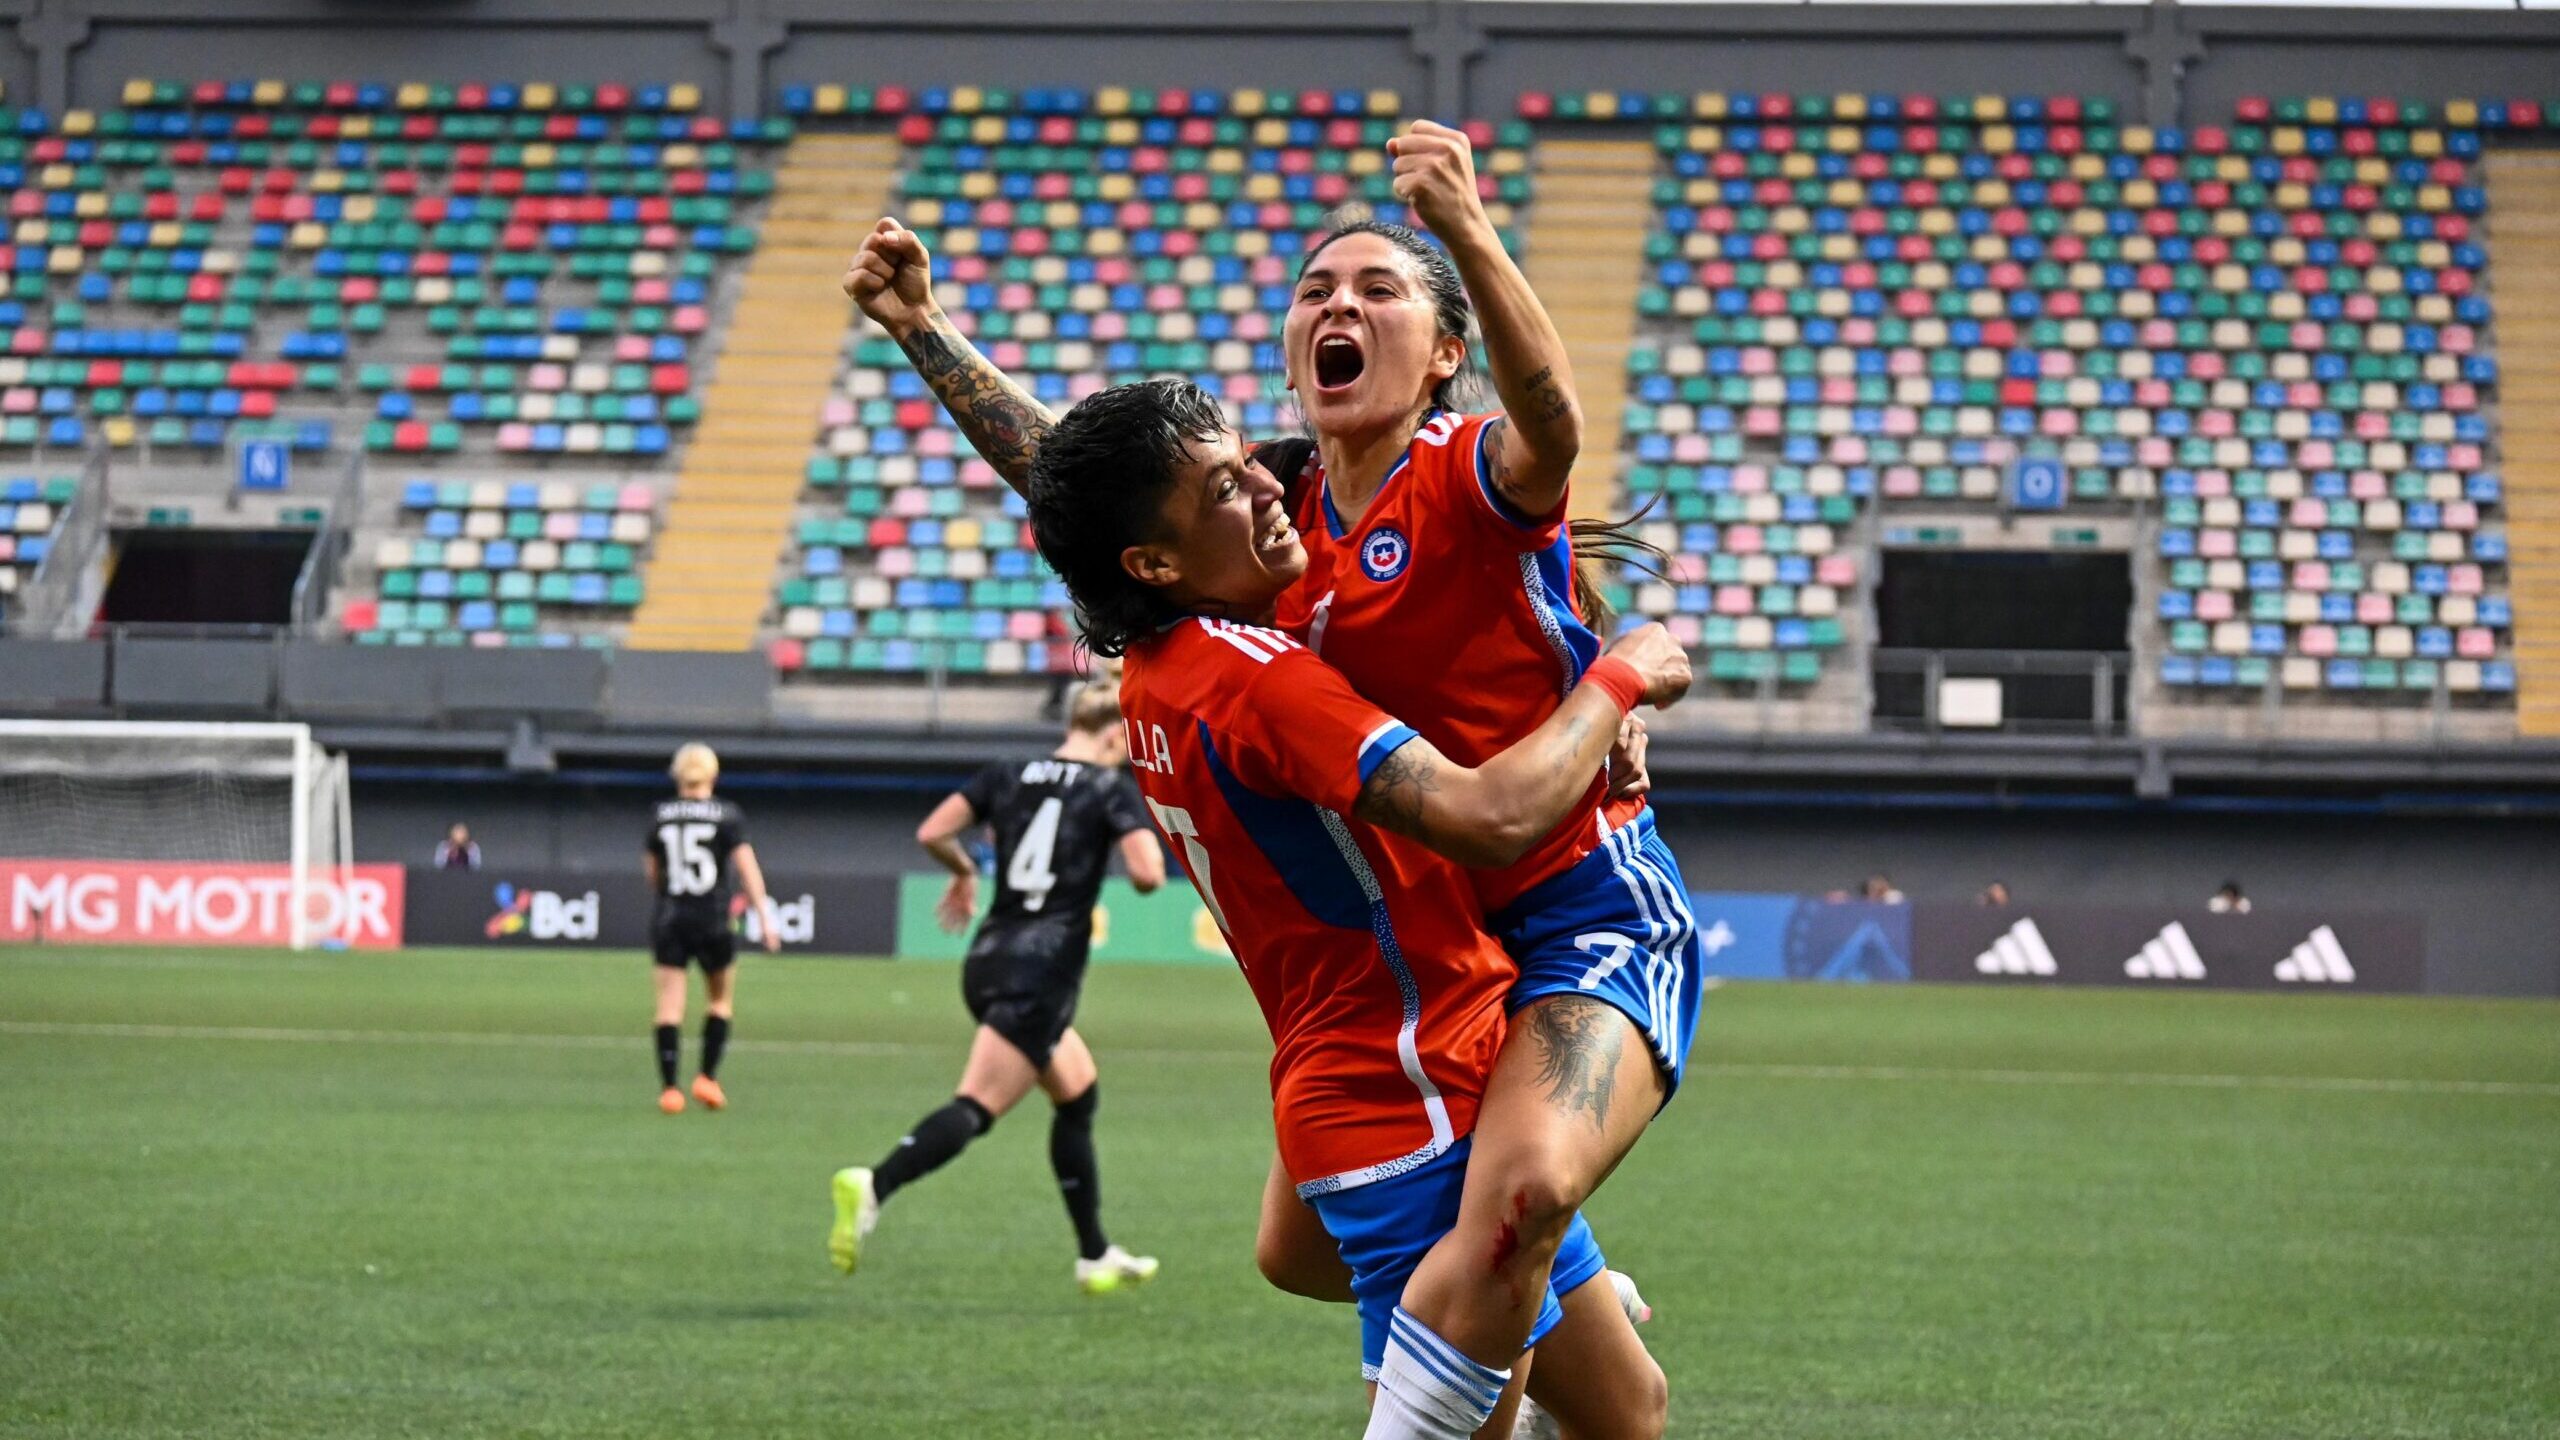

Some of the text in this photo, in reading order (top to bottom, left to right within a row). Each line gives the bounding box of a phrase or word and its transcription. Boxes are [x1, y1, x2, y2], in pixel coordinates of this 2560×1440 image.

[1121, 716, 1175, 775] LLA
[658, 822, 718, 896] 15
[1007, 796, 1063, 913] 4
[11, 872, 391, 939] MG MOTOR
[530, 890, 599, 939] Bci
[1574, 931, 1636, 990] 7
